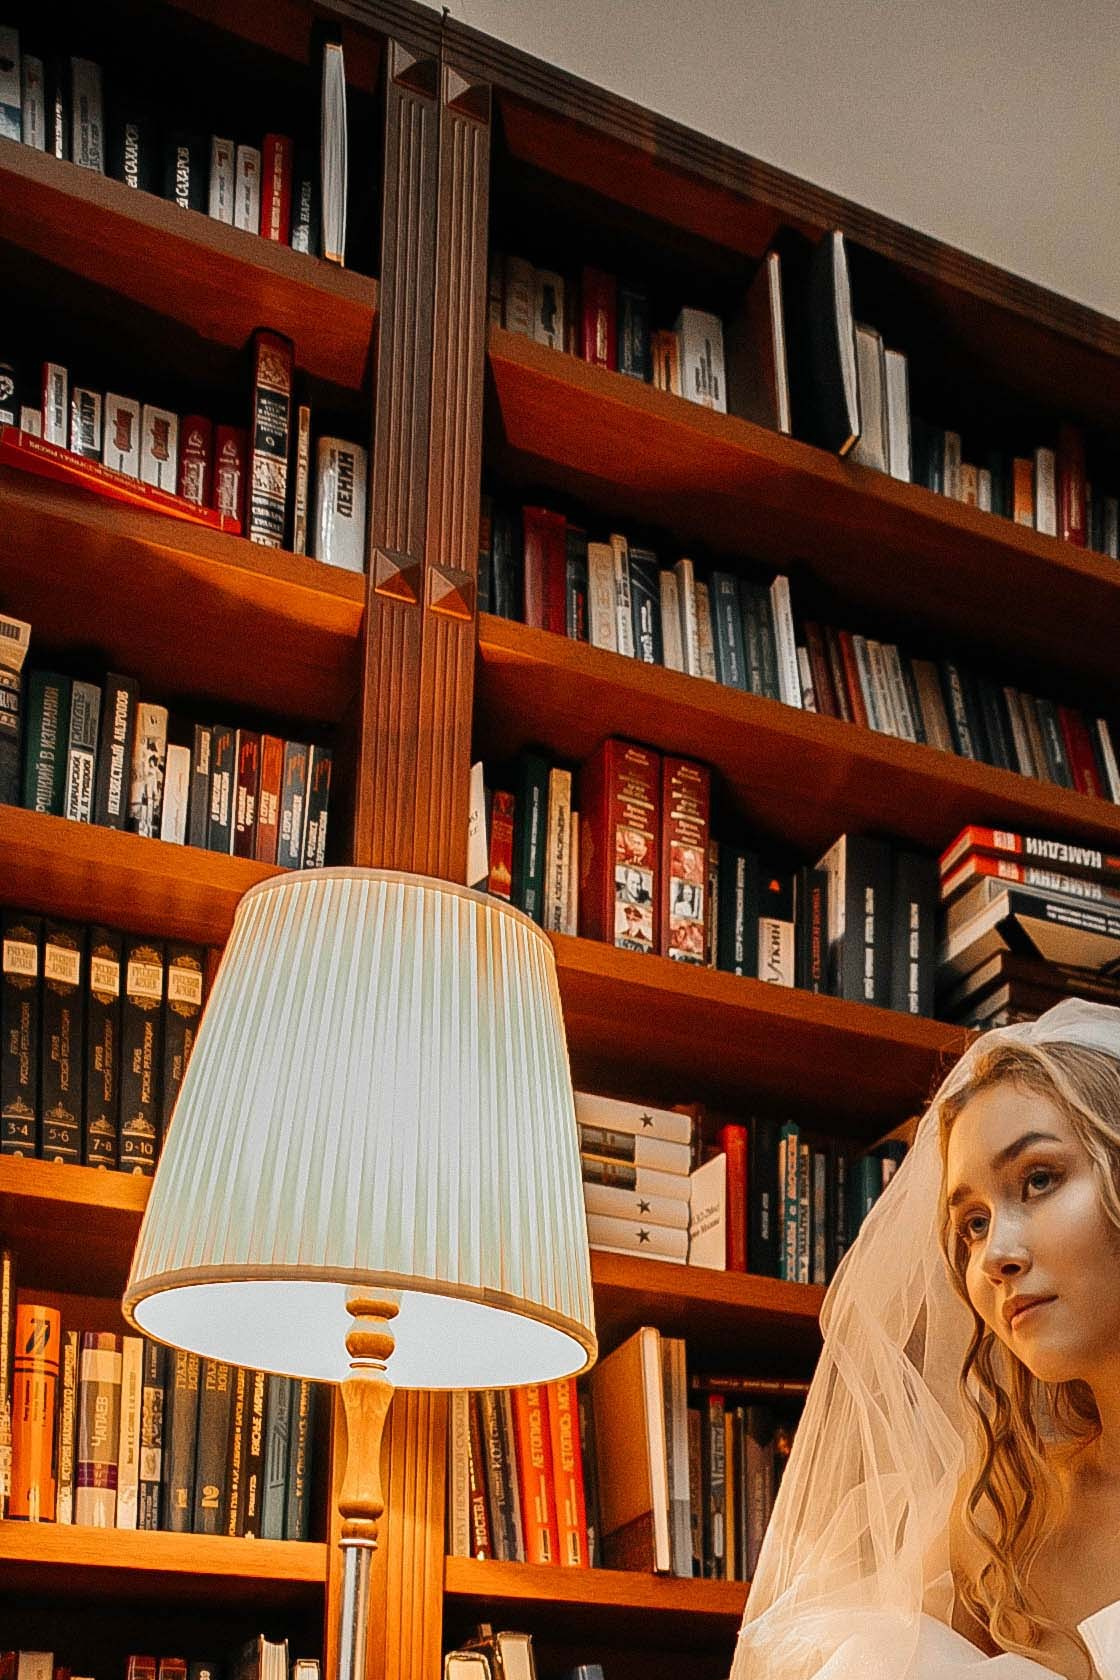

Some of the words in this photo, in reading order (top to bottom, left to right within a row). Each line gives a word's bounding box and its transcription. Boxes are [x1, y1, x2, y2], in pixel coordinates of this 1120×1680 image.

[337, 450, 354, 518] ЛЕНИН
[41, 686, 58, 749] ИЗГНАНИИ
[114, 690, 128, 743] АНДРОПОВ
[40, 750, 55, 760] В
[35, 761, 55, 813] РОЦКИЙ
[108, 744, 124, 816] НЕИЗВЕСТНЫЙ
[1026, 838, 1101, 868] НАМЕДНИ
[1029, 868, 1102, 900] НАМЕДНИ
[133, 1048, 142, 1074] АРХИВ
[142, 1071, 151, 1104] РУССКОЙ
[8, 1123, 29, 1137] 3-4
[49, 1129, 70, 1143] 5-6
[93, 1138, 113, 1152] 7-8
[125, 1141, 153, 1155] 9-10
[205, 1360, 216, 1392] ГРАЖ
[91, 1396, 109, 1448] ЧАПАЕВ
[529, 1409, 544, 1468] ЛЕТОПИСЬ
[559, 1412, 574, 1472] ЛЕТОПИСЬ
[175, 1489, 187, 1508] 1
[201, 1486, 219, 1509] 2
[474, 1496, 488, 1547] МОСКВА
